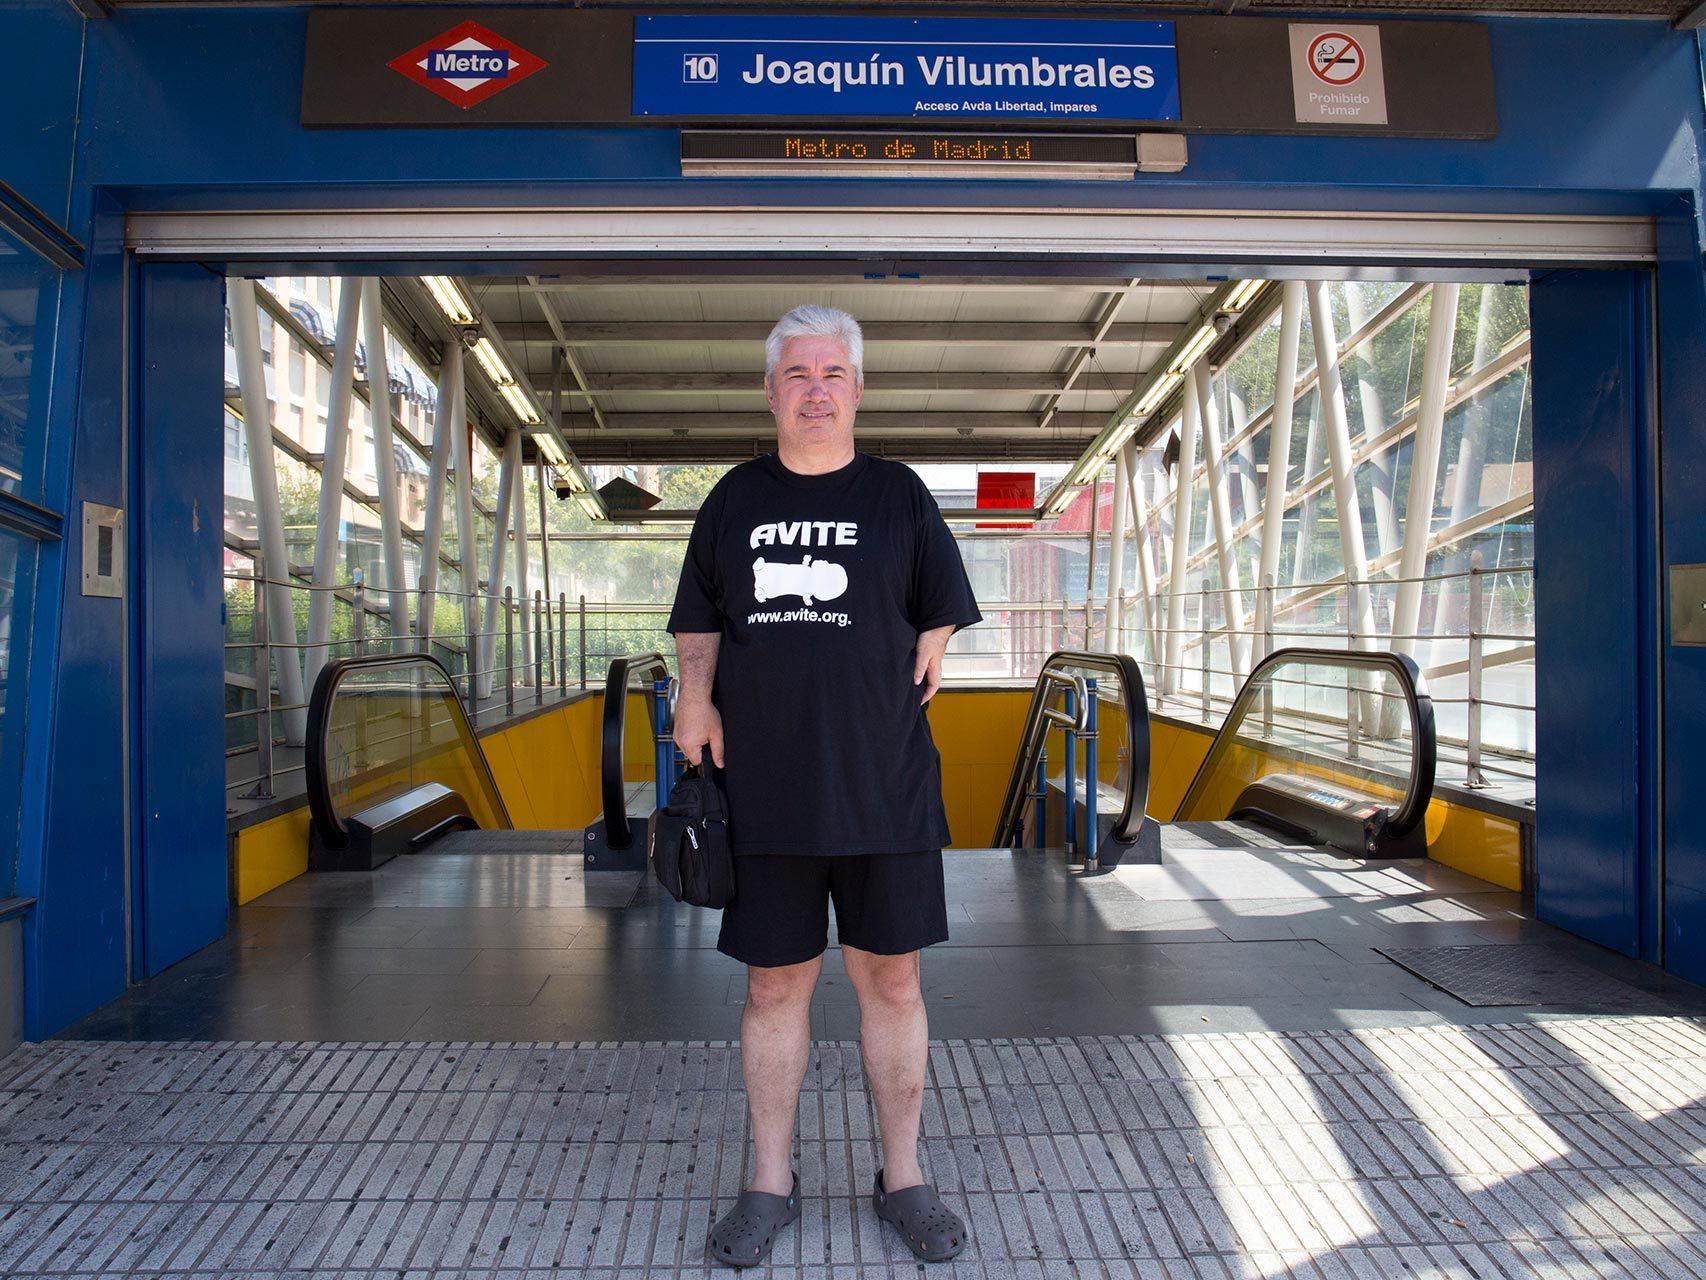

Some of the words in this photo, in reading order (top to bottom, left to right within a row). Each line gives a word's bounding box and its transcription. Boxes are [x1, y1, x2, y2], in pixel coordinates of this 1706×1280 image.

[434, 52, 503, 73] Metro
[685, 57, 717, 79] 10
[742, 53, 904, 93] Joaquín
[916, 56, 1155, 89] Vilumbrales
[914, 101, 959, 111] Acceso
[962, 101, 992, 111] Avda
[995, 101, 1047, 112] Libertad,
[1309, 92, 1370, 104] Prohibido
[1320, 104, 1361, 115] Fumar
[785, 138, 867, 158] Metro
[885, 139, 916, 158] de
[933, 140, 1031, 159] Madrid
[750, 521, 858, 550] AVITE
